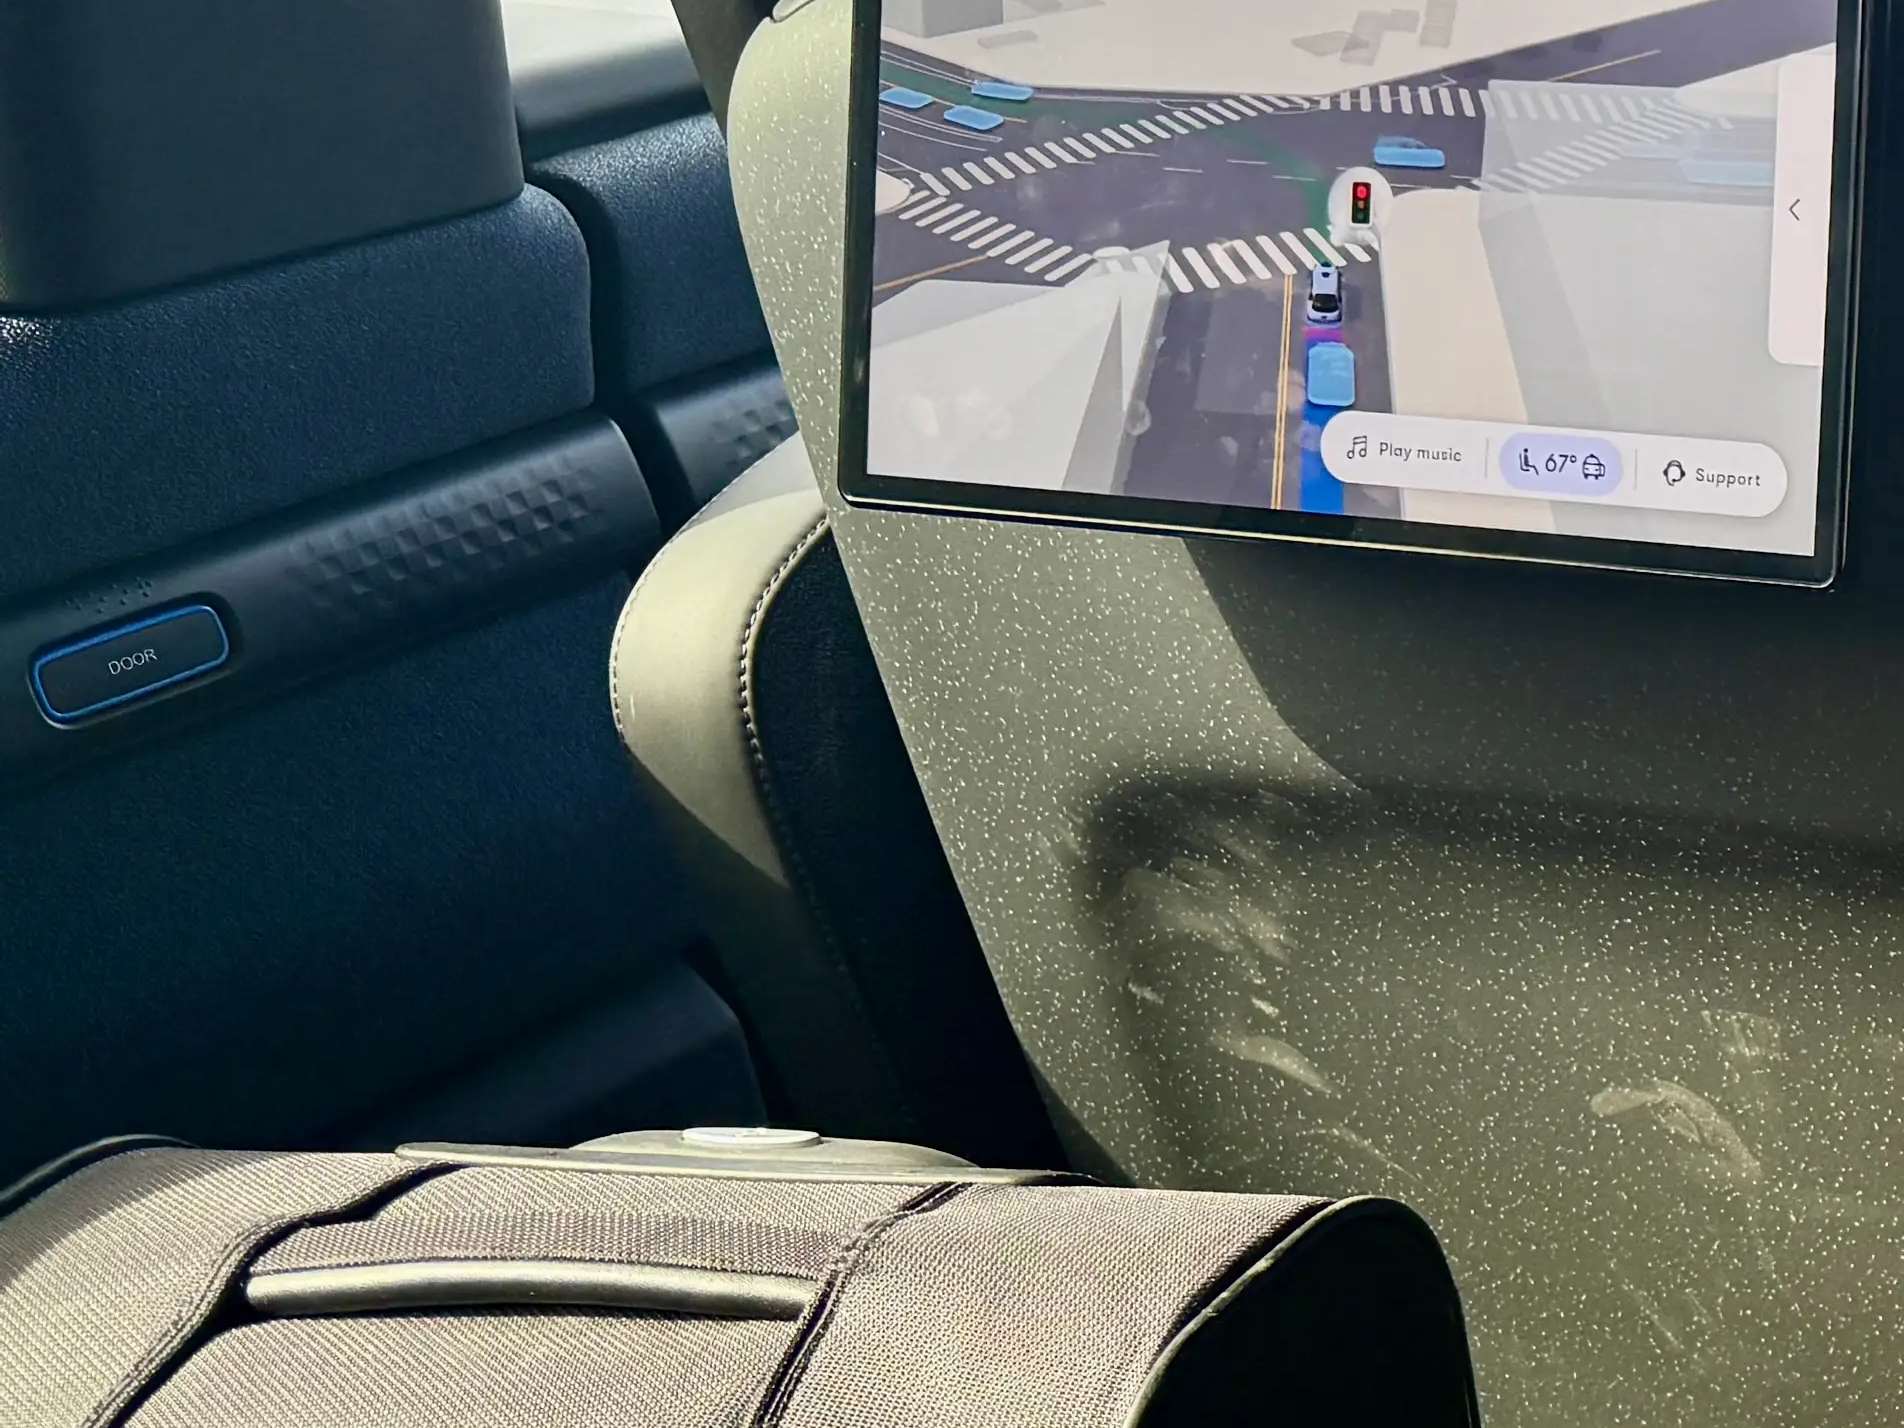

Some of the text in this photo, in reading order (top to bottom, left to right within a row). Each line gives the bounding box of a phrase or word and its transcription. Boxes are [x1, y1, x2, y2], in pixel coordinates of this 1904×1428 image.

[1379, 441, 1462, 463] Play music
[1544, 453, 1578, 474] 67°
[1695, 468, 1761, 489] Support
[107, 648, 158, 675] DOOR
